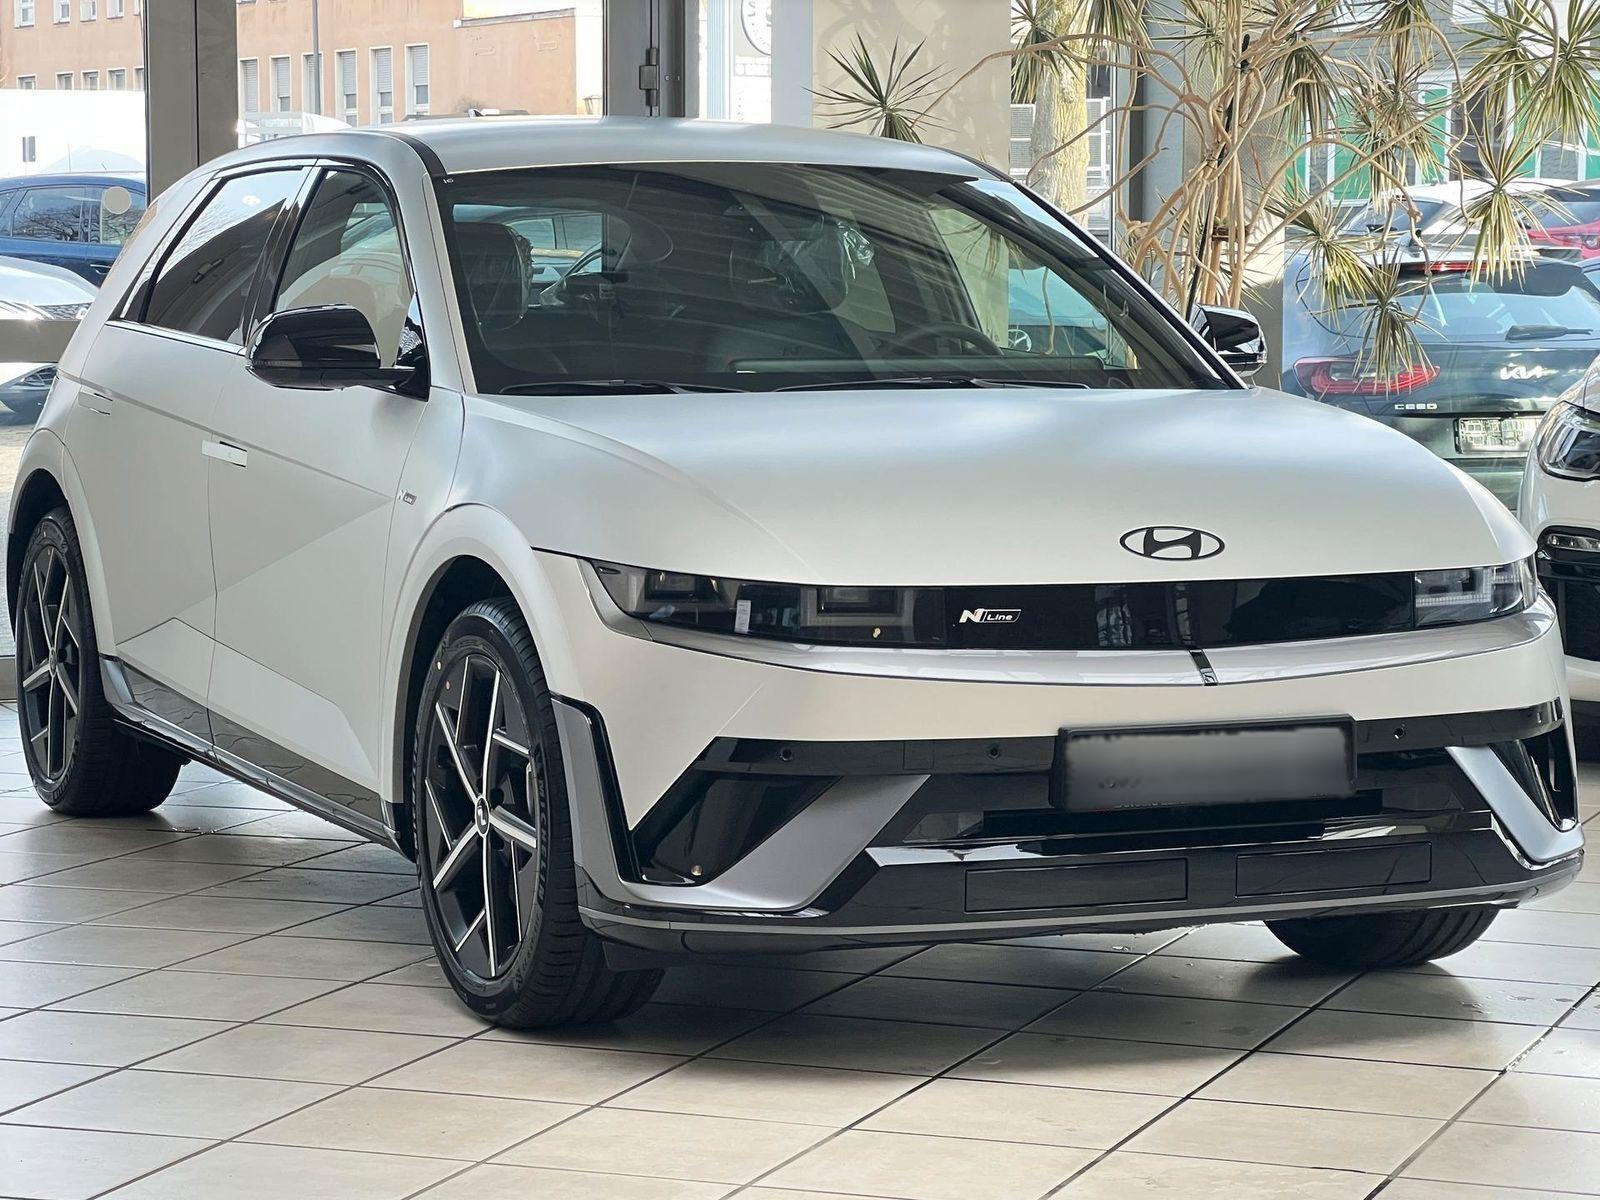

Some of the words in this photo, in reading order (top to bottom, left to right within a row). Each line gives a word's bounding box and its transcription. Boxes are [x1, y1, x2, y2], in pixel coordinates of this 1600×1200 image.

[1499, 365, 1544, 380] KIA
[958, 608, 984, 623] N
[986, 613, 1013, 621] Line
[538, 779, 549, 901] MICHELIN
